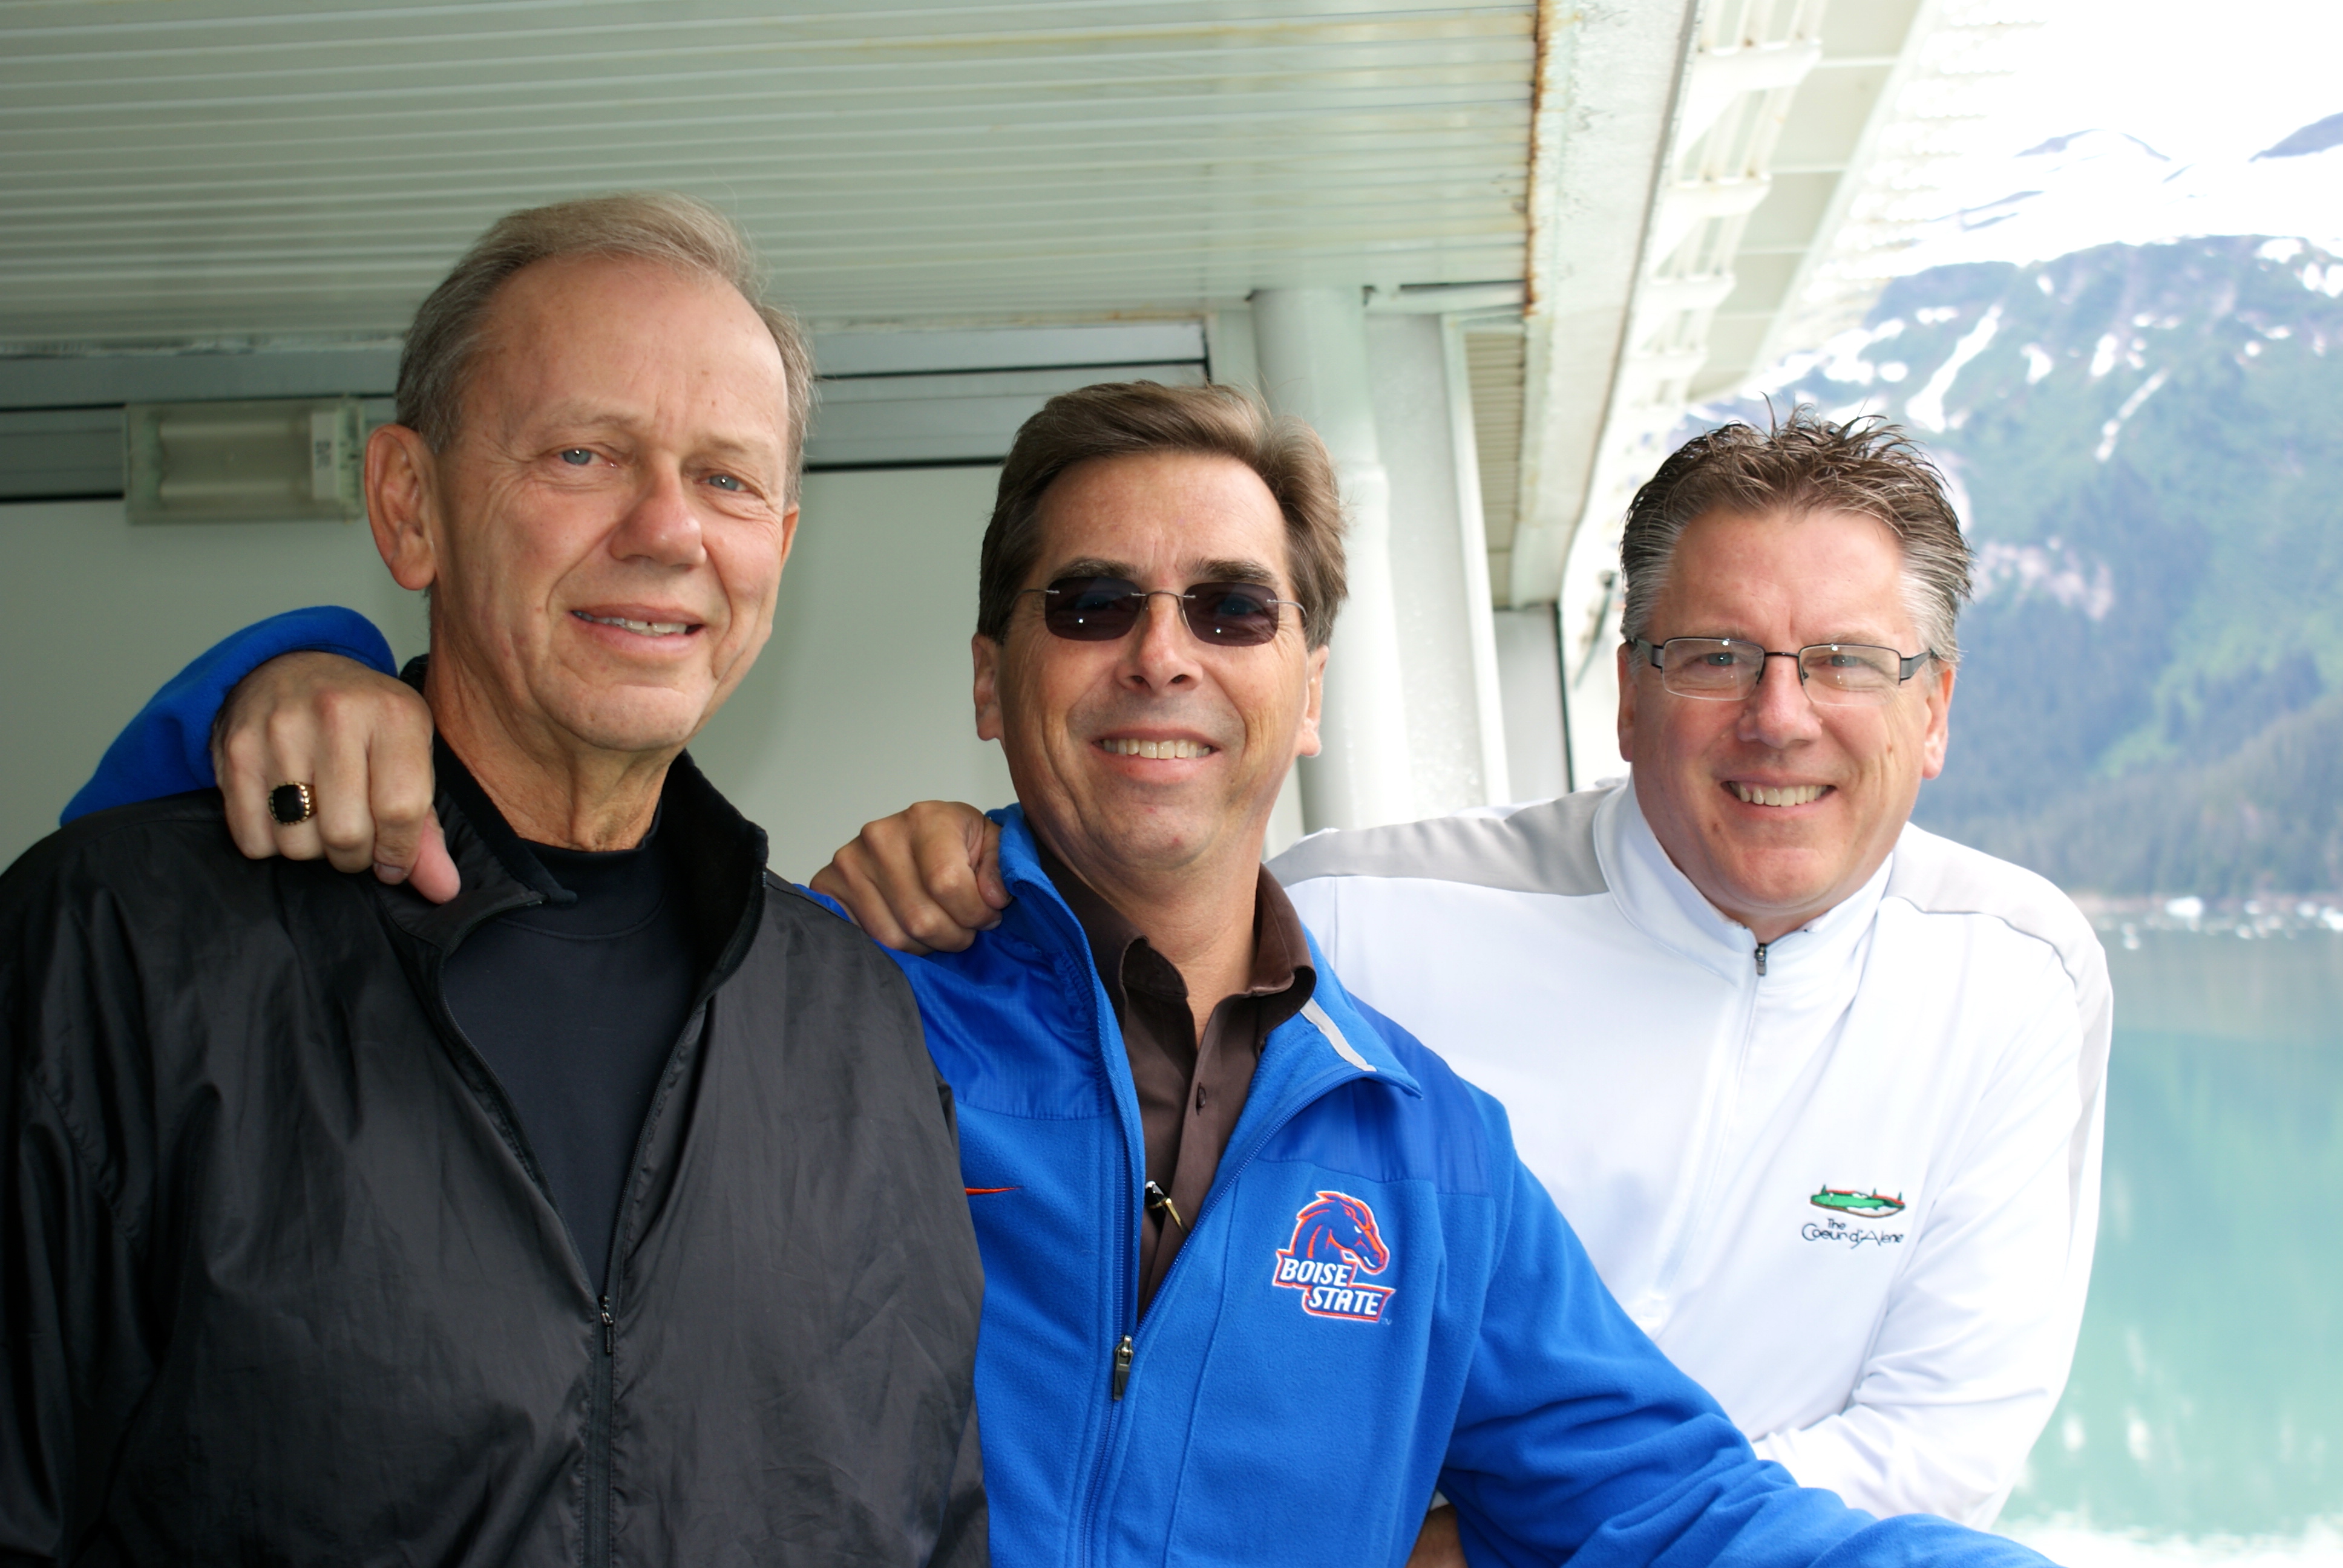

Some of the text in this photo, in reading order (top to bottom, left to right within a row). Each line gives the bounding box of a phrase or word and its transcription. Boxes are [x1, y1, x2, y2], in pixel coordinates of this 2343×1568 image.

[1801, 1223, 1848, 1241] Coeur
[1827, 1218, 1846, 1230] The
[1280, 1258, 1352, 1287] BOISE
[1308, 1286, 1383, 1315] STATE
